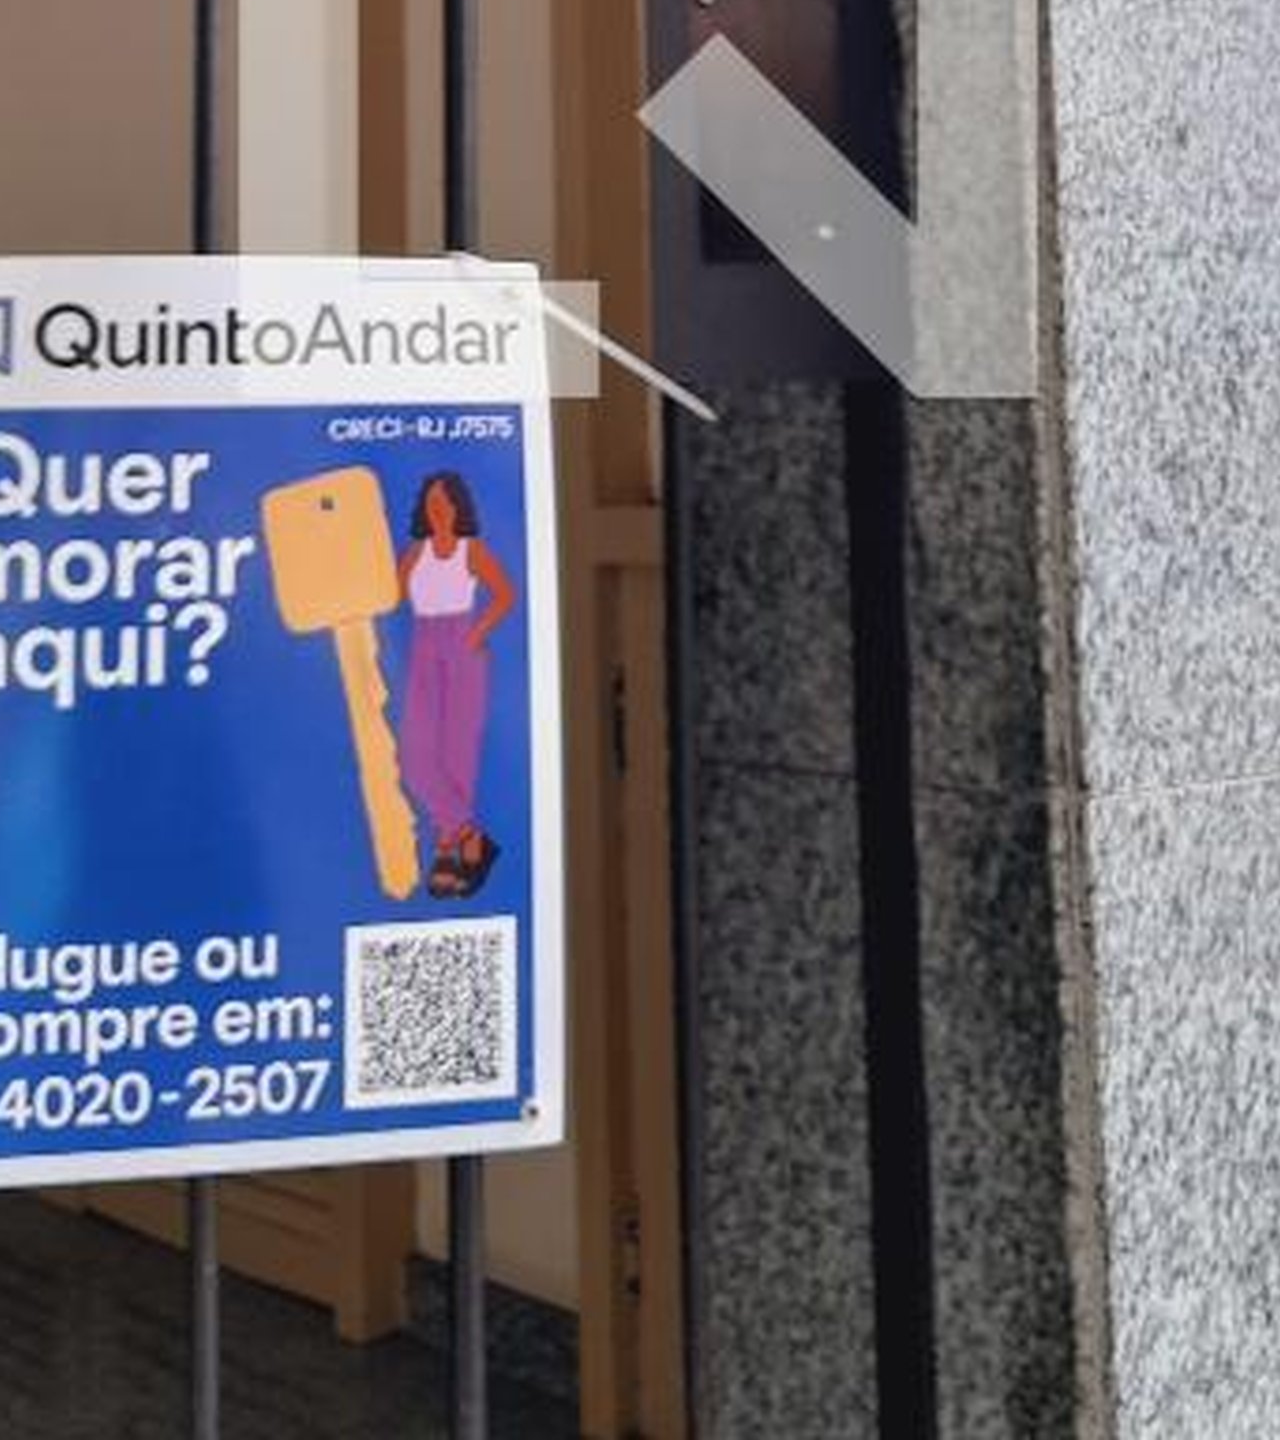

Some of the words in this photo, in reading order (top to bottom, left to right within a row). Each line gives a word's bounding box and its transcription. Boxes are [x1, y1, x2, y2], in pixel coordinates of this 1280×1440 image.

[35, 301, 520, 368] QuintoAndar
[196, 934, 279, 980] ou
[214, 992, 334, 1048] em:
